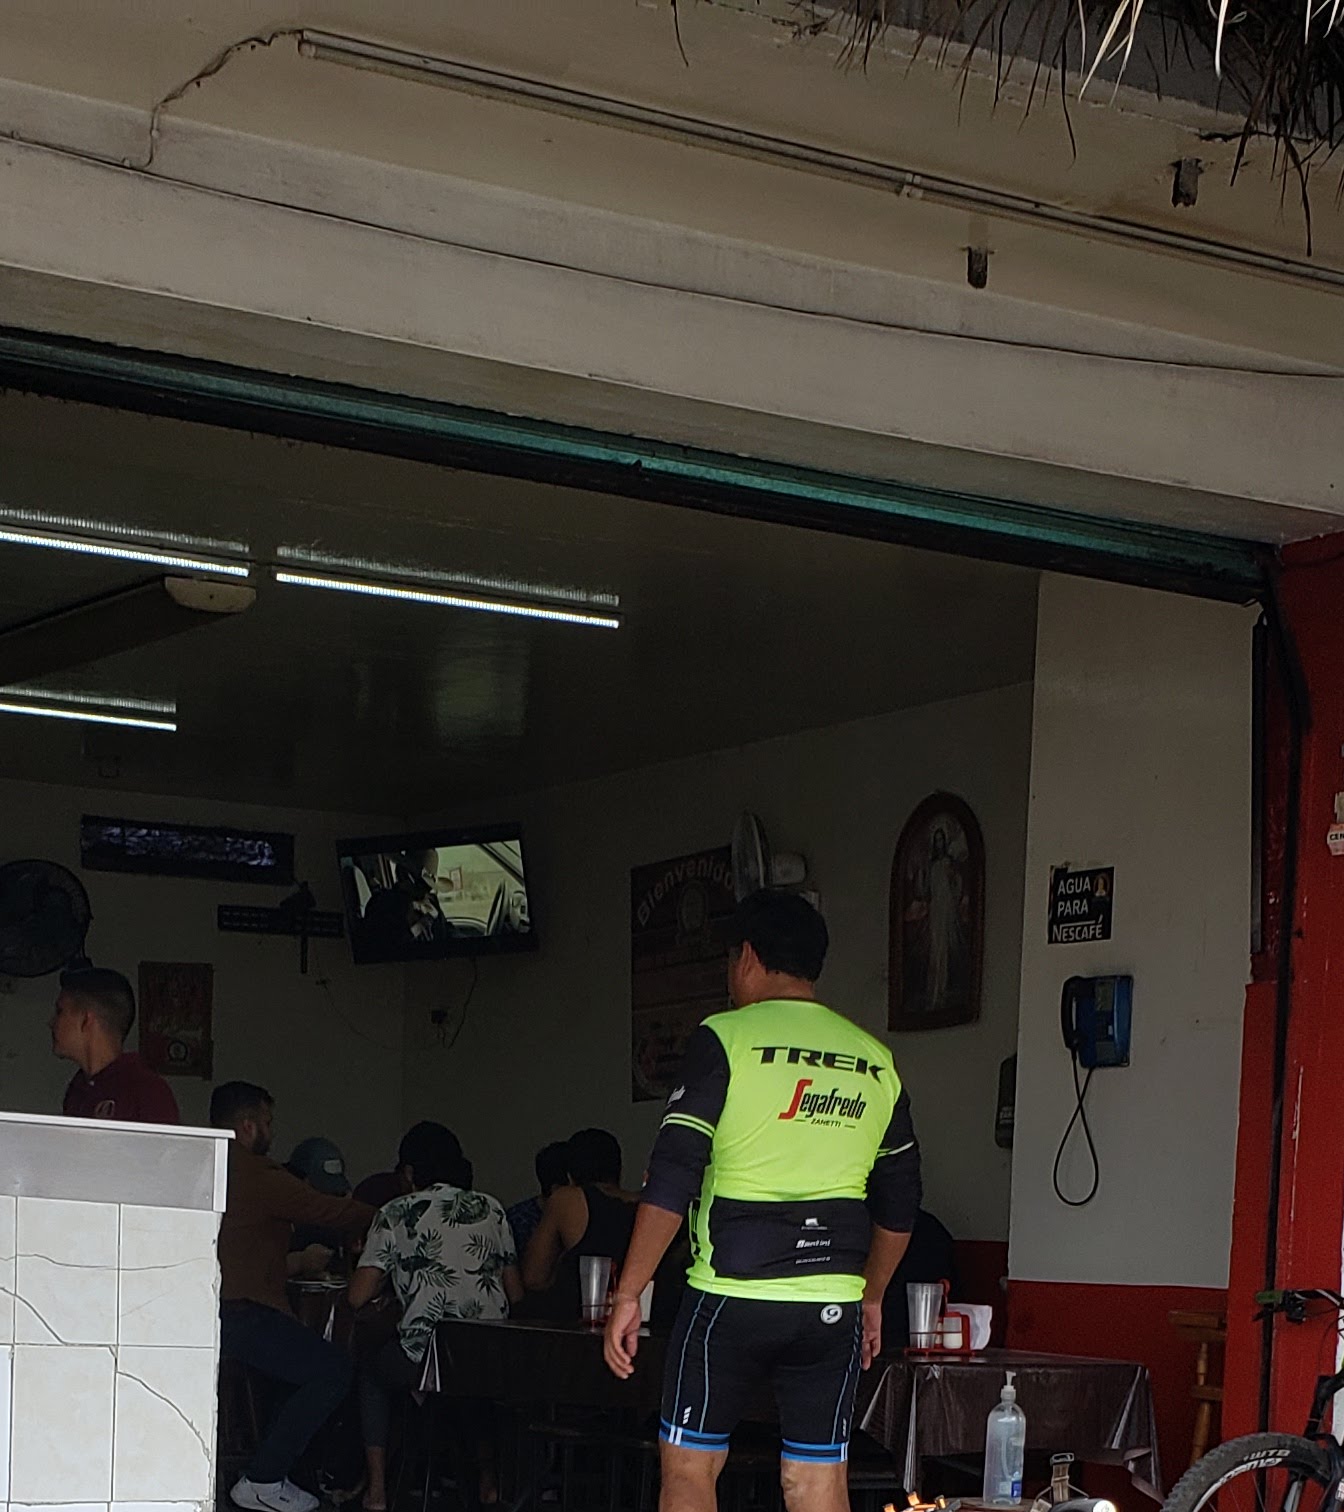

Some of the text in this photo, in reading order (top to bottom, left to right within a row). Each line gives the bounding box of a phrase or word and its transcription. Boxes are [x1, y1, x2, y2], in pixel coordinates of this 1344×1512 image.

[1057, 876, 1091, 896] AGUA
[1057, 898, 1089, 918] PARA
[751, 1046, 886, 1085] TREK
[777, 1078, 867, 1120] Segafredo
